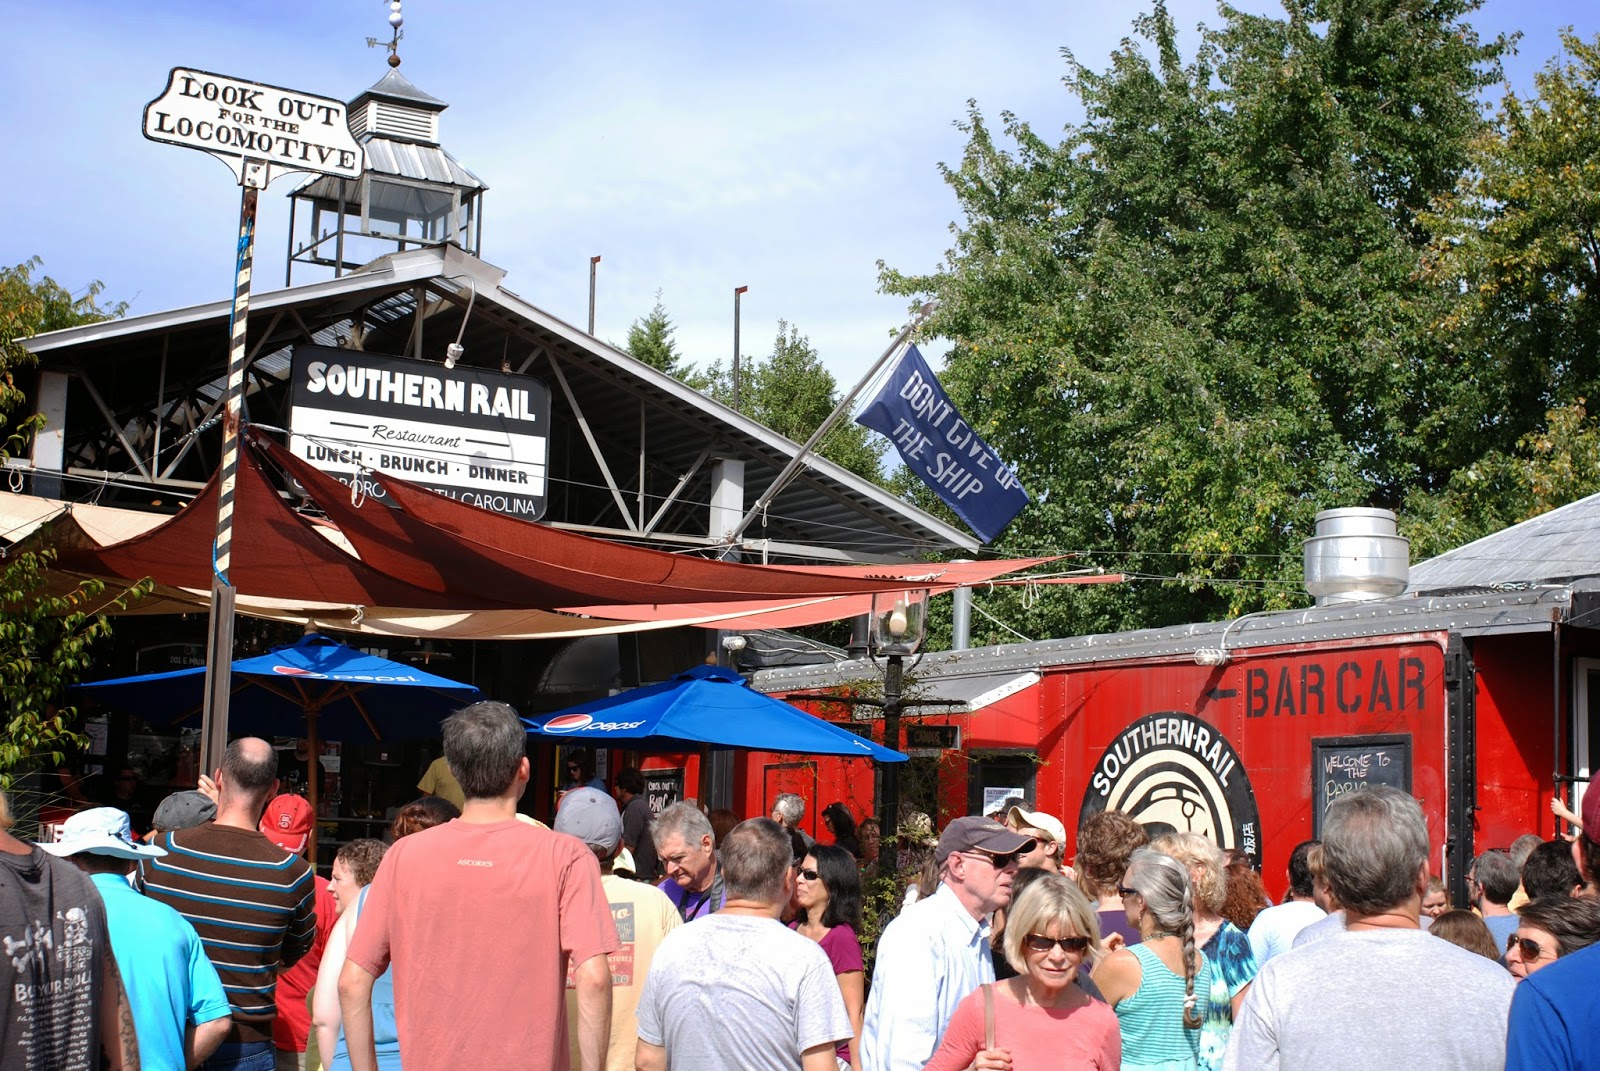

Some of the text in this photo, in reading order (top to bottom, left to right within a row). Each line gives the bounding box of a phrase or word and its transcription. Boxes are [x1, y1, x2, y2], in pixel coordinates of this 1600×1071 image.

[179, 76, 340, 126] LOOK OUT
[218, 108, 299, 134] FOR THE
[154, 111, 356, 170] LOCOMOTIVE
[306, 361, 536, 422] SOUTHERN RAIL
[372, 424, 461, 448] Restaurant
[946, 418, 993, 469] GIVE
[994, 465, 1020, 490] UP
[306, 445, 528, 484] LUNCH BRUNCH DINNER
[892, 418, 983, 500] THE SHIP
[333, 674, 417, 683] pepsi
[1246, 657, 1426, 718] BAR CAR
[581, 720, 646, 732] pepsi
[1093, 718, 1235, 796] SOUTHERN RAIL
[1324, 754, 1372, 774] WELCOME
[1343, 767, 1369, 779] THE
